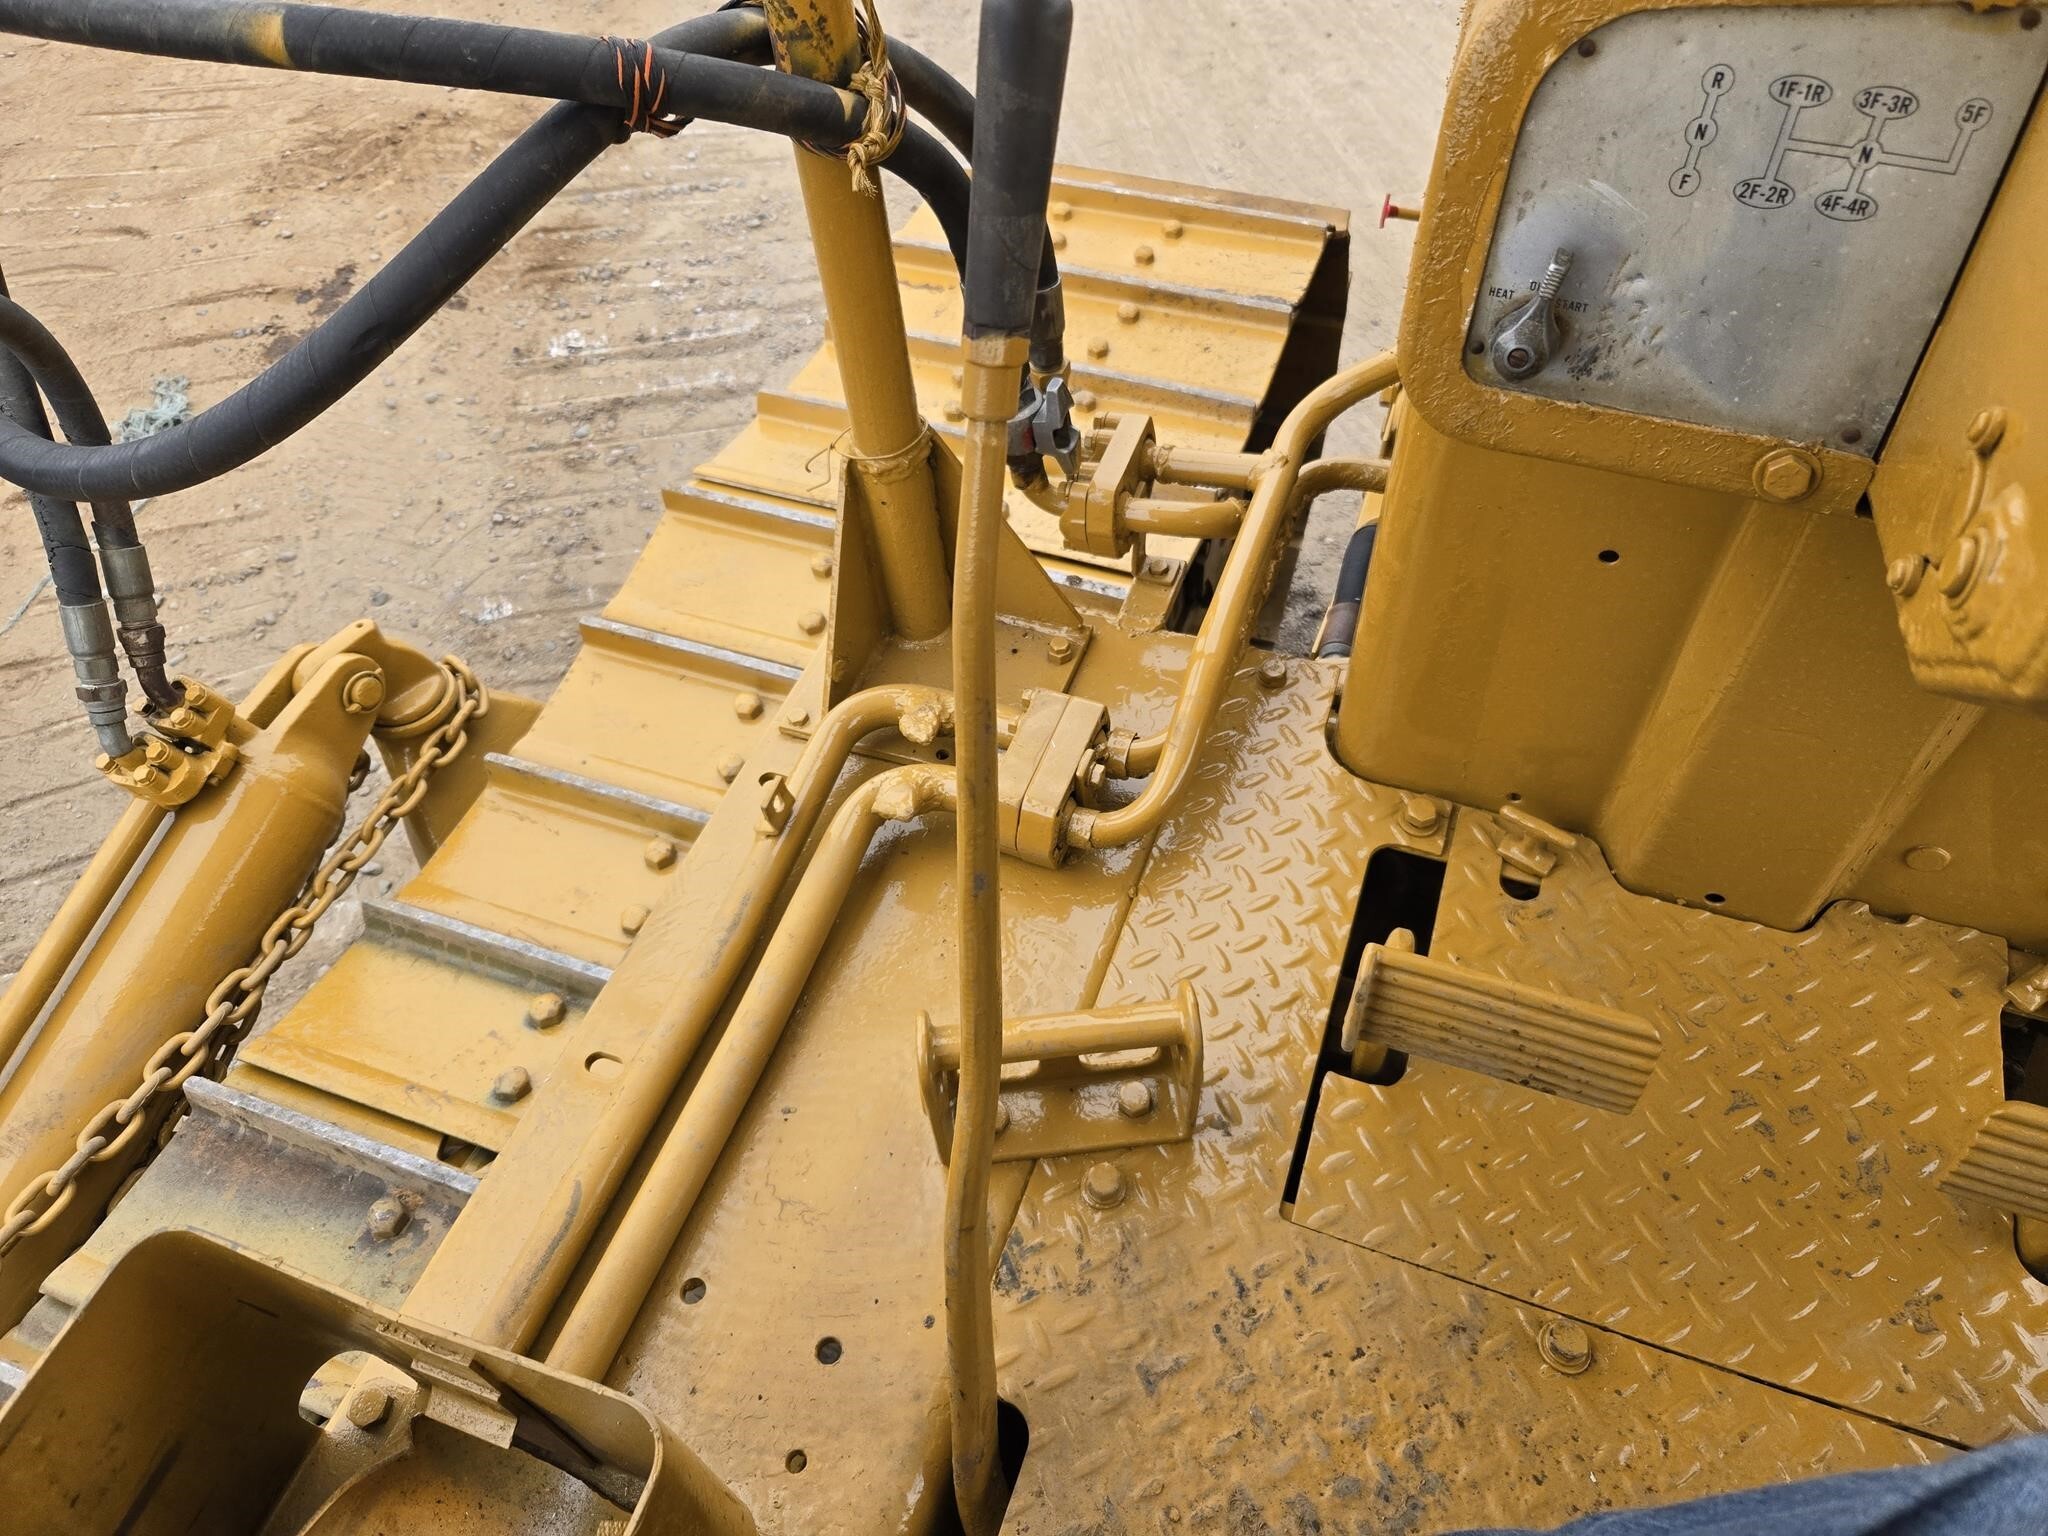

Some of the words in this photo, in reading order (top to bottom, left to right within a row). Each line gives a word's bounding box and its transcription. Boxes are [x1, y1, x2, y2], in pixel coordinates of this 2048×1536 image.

[1711, 71, 1725, 89] R
[1778, 80, 1825, 102] 1F-1R
[1858, 91, 1913, 115] 3F-3R
[1961, 104, 1989, 124] 5F
[1694, 123, 1708, 141] N
[1858, 146, 1873, 164] N
[1678, 174, 1692, 190] F
[1738, 182, 1789, 205] 2F-2R
[1821, 195, 1870, 217] 4F-4R
[1488, 287, 1515, 300] HEAT
